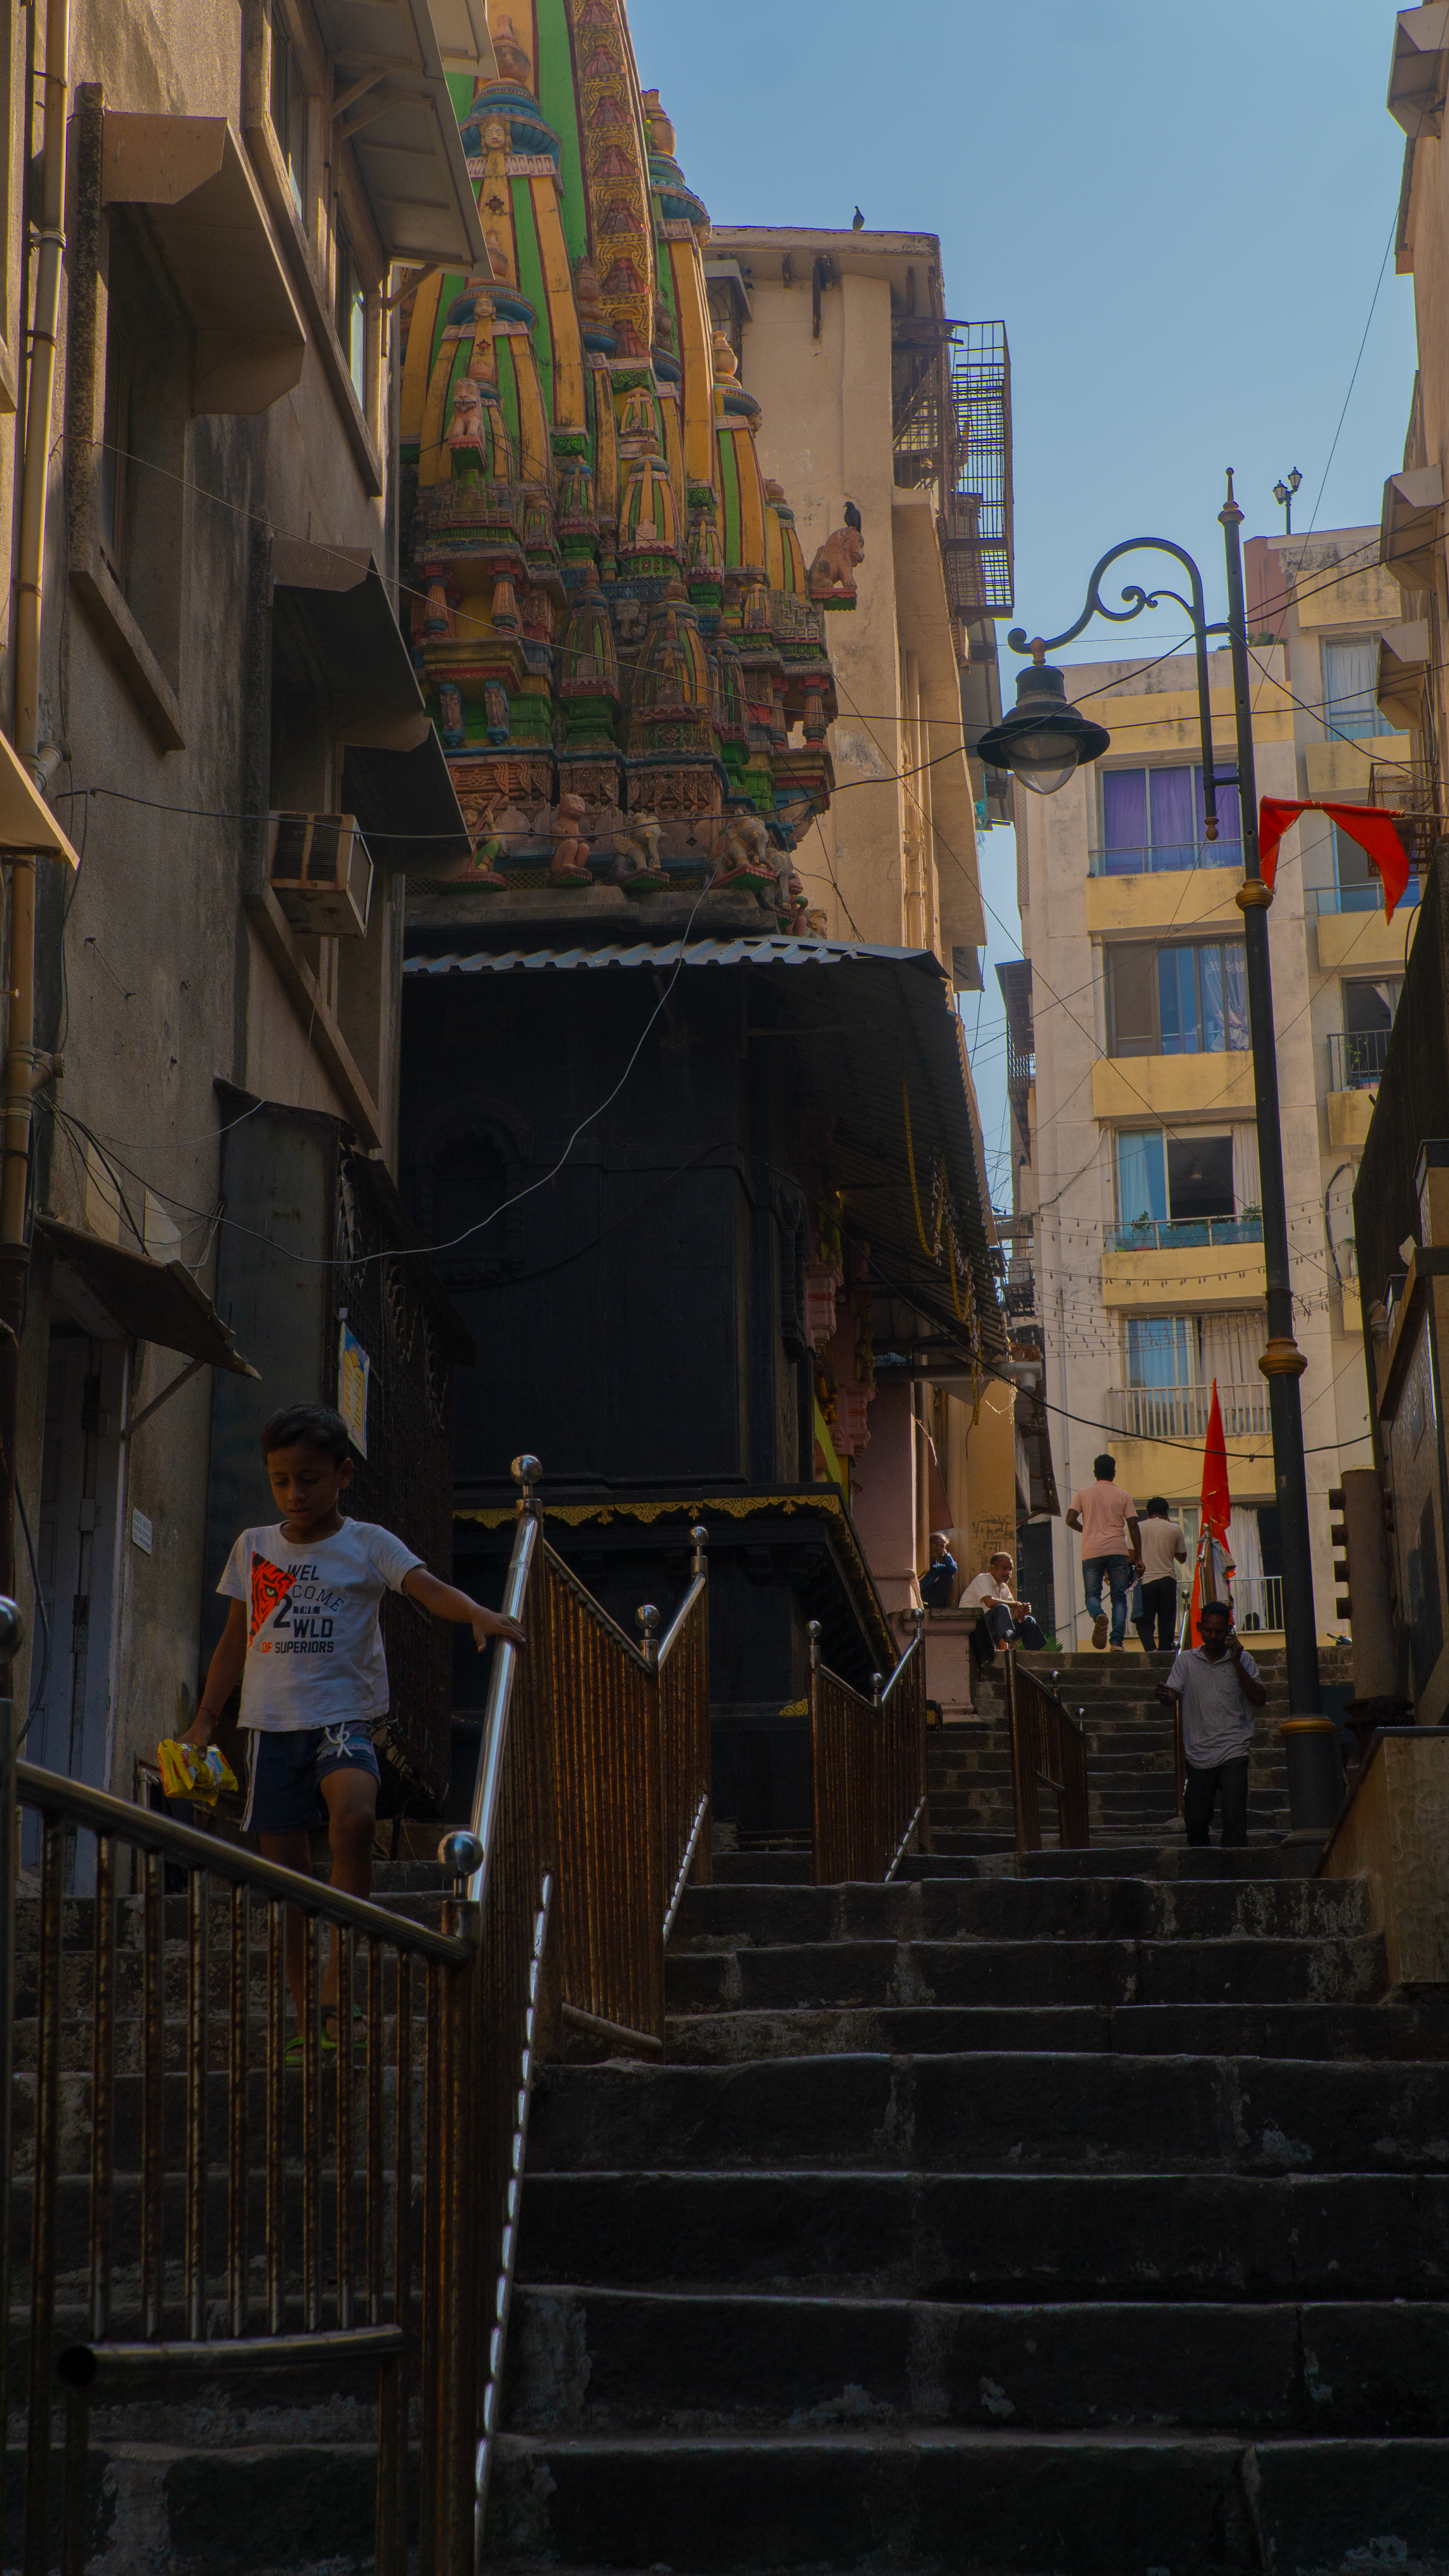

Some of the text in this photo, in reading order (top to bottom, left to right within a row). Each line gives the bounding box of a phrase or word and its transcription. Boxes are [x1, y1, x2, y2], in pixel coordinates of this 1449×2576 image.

[287, 1564, 320, 1581] WEL
[293, 1585, 344, 1612] COME
[273, 1593, 293, 1628] 2
[294, 1619, 333, 1638] WLD
[262, 1641, 334, 1653] OF SUPERIORS
